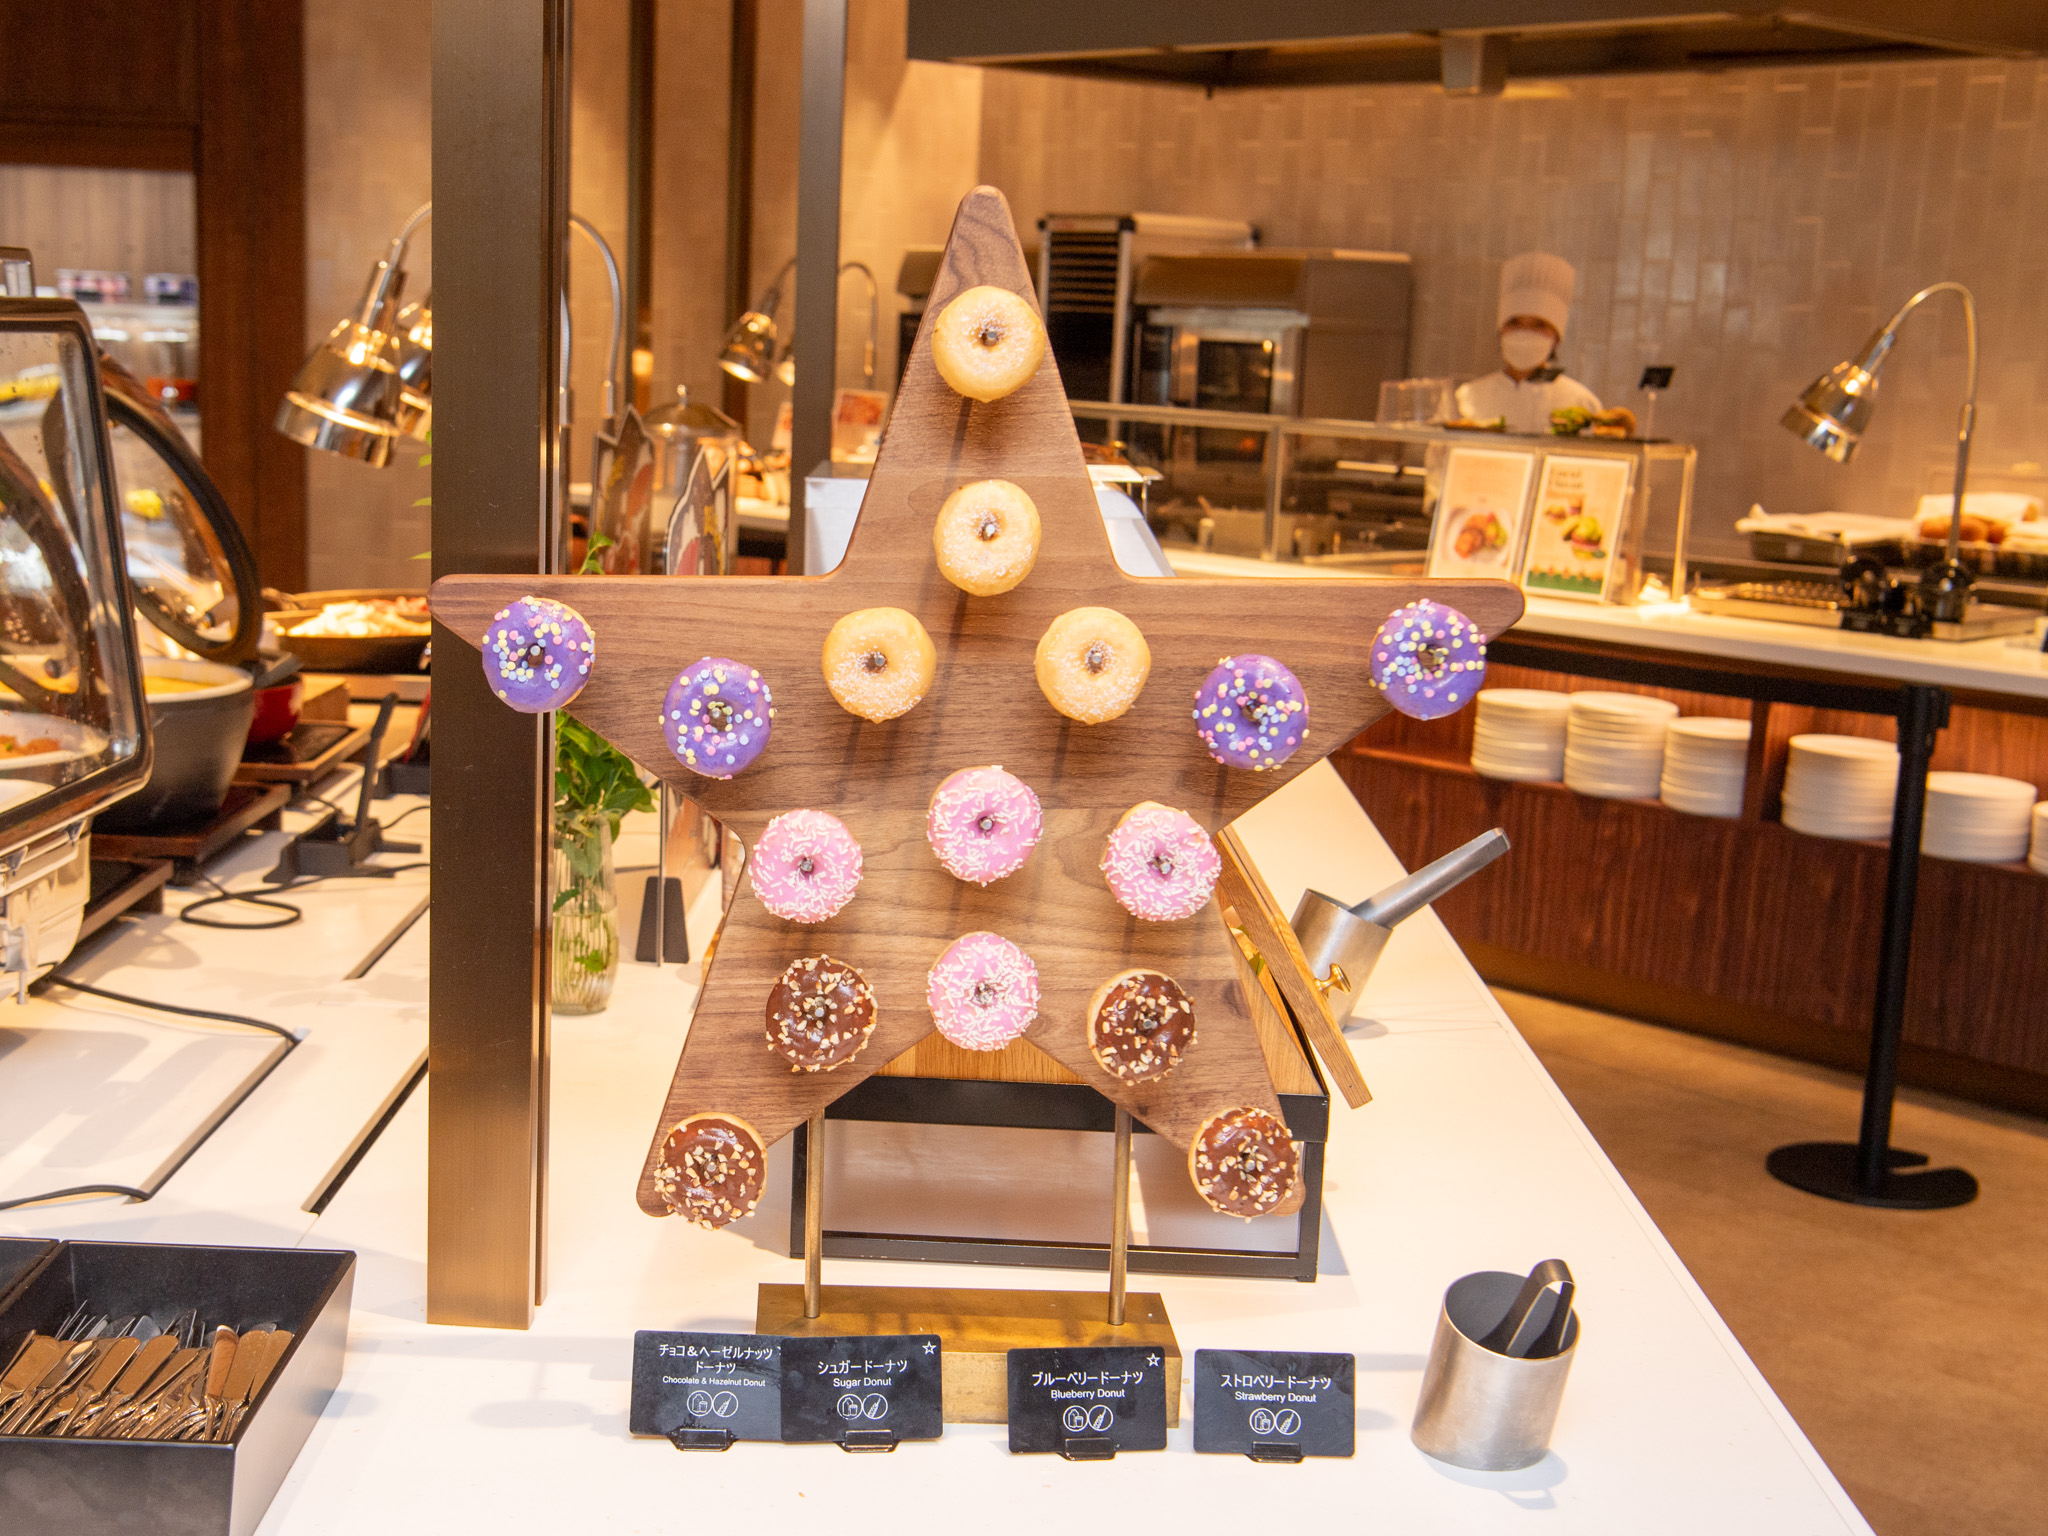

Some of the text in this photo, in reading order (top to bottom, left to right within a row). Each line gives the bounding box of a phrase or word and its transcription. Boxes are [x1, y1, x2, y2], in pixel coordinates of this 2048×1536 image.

[696, 1360, 736, 1374] ドーナツ
[817, 1359, 908, 1375] シュガードーナツ
[662, 1375, 699, 1385] Chocolate
[709, 1378, 742, 1386] Hazelnut
[743, 1379, 766, 1387] Donut
[833, 1377, 892, 1388] Sugar Donut
[1032, 1370, 1144, 1387] ブルーベリードーナツ
[1220, 1373, 1332, 1390] ストロベリードーナツ
[1051, 1388, 1126, 1400] Blueberry Donut
[1234, 1391, 1317, 1404] Strawberry Donut
